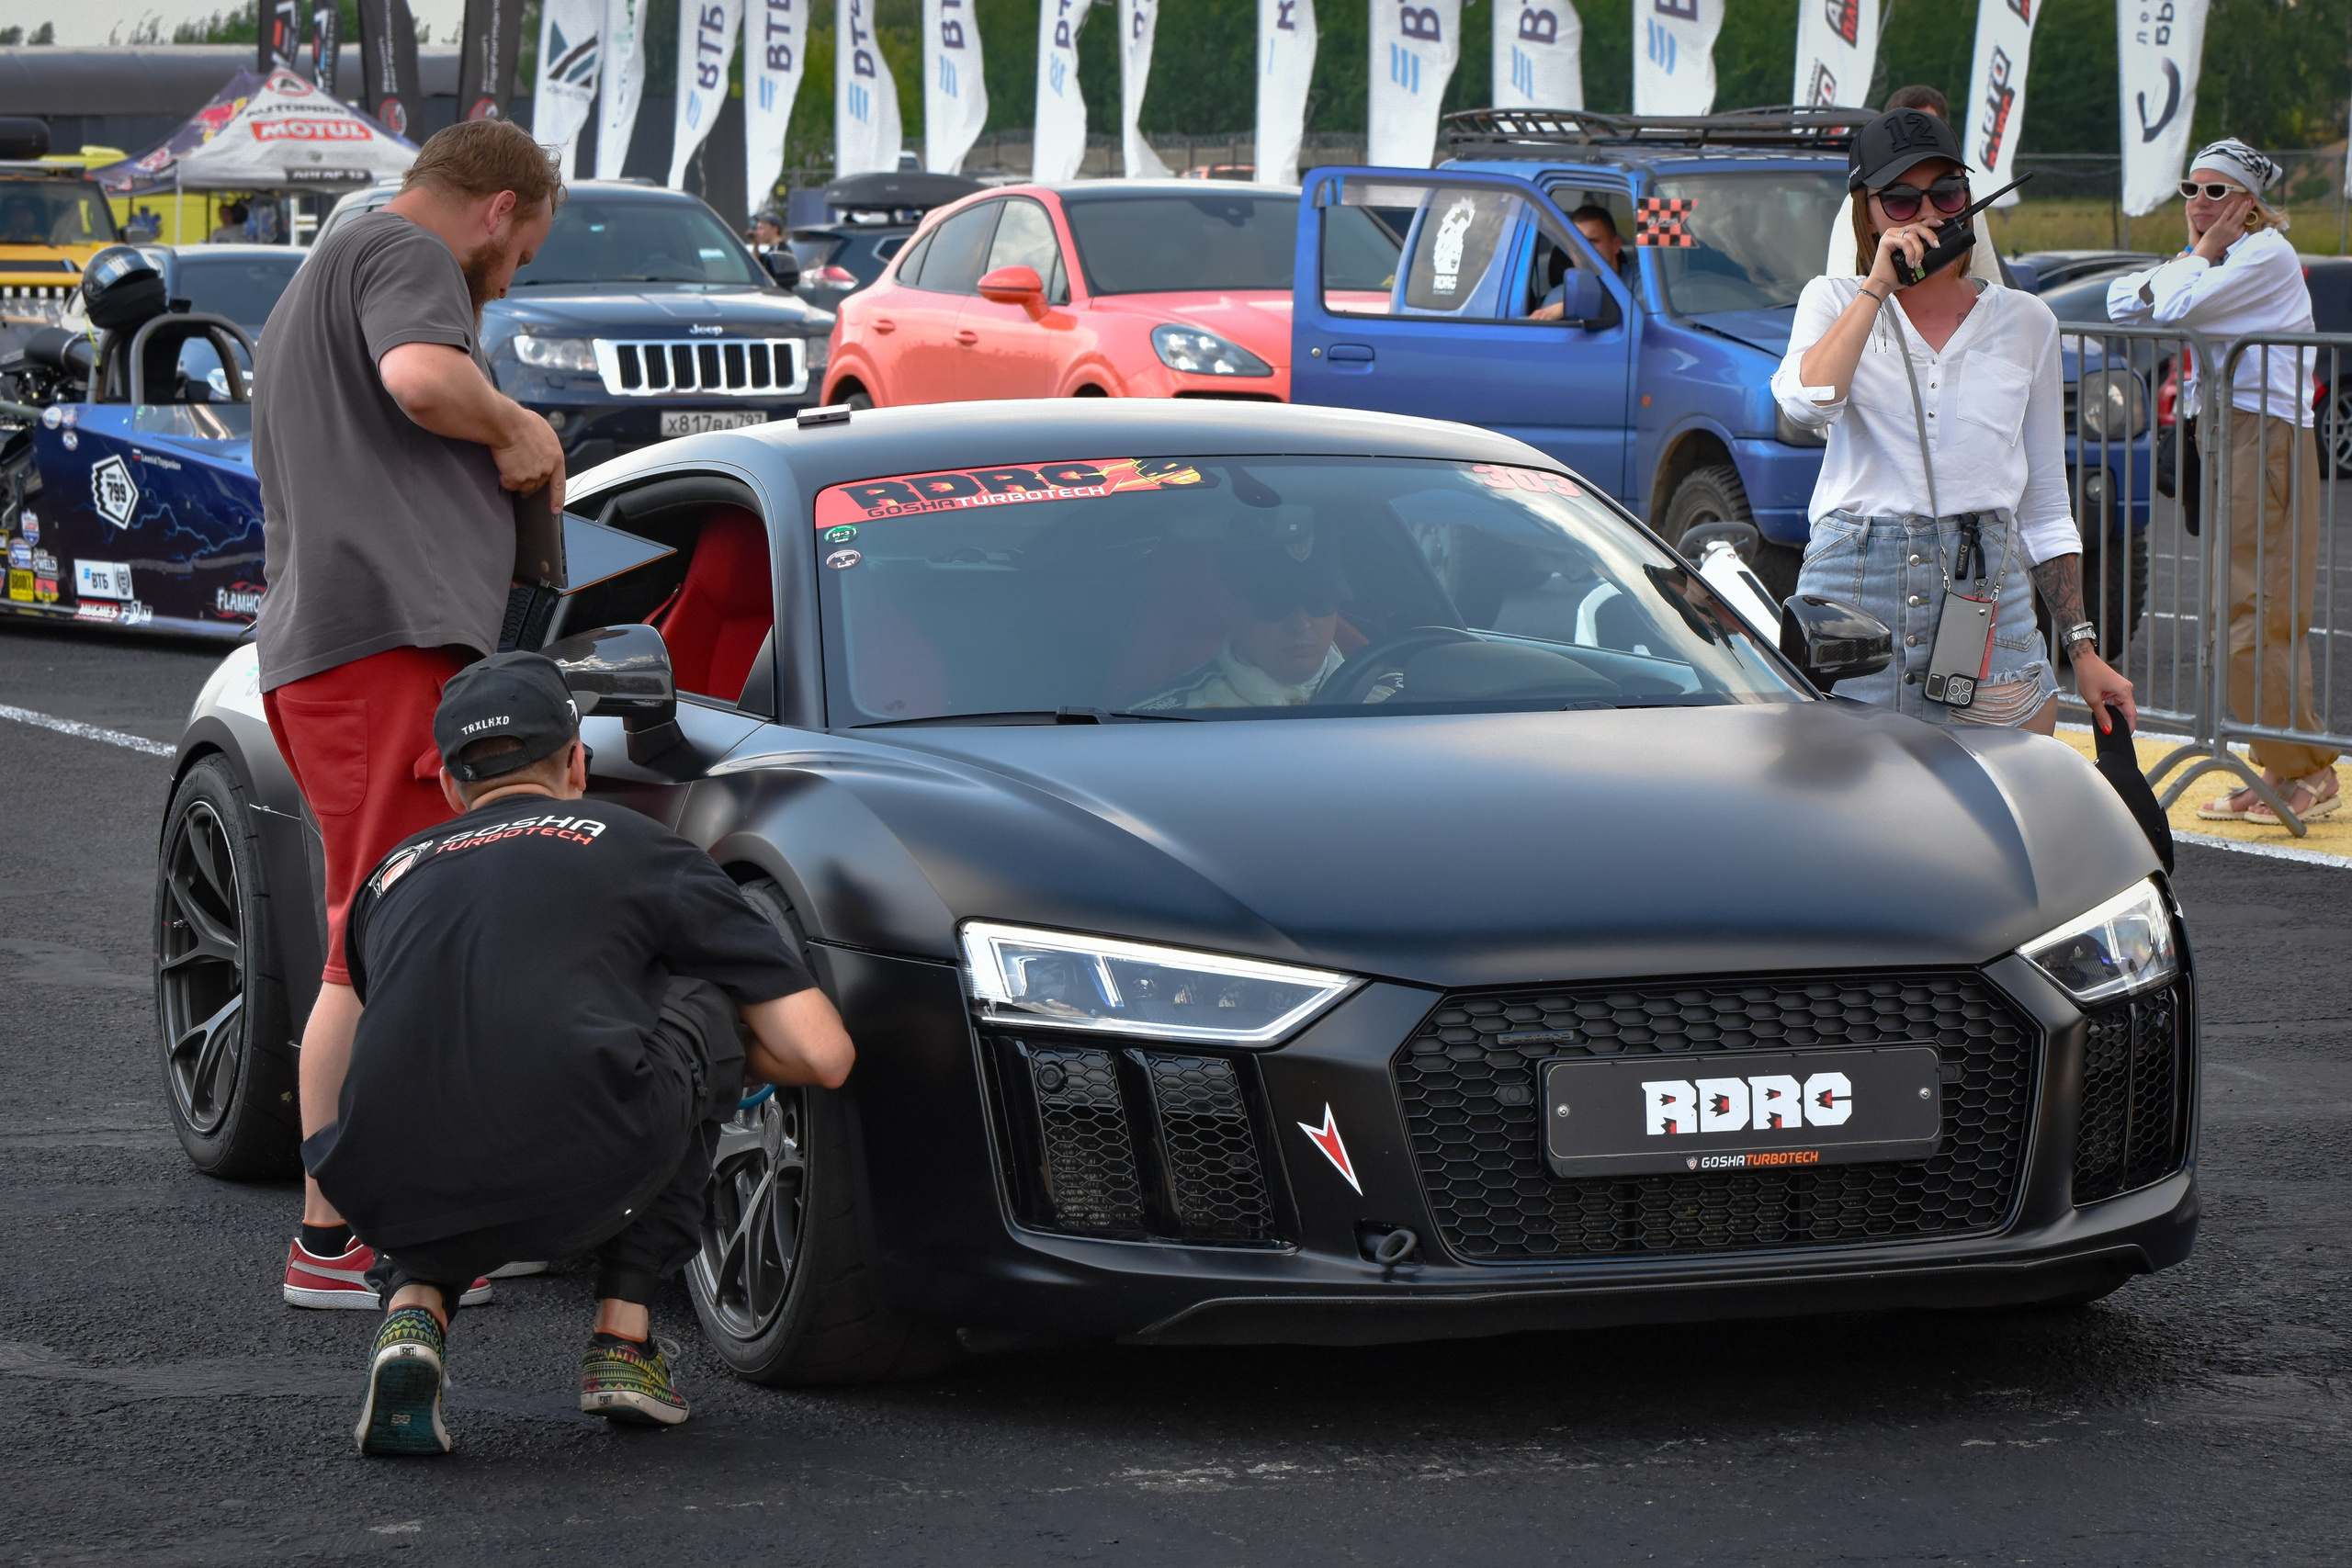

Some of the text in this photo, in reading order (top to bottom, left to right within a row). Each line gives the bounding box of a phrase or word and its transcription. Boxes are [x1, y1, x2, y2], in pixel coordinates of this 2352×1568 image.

[261, 122, 366, 138] MOTUL
[1884, 112, 1939, 153] 12
[689, 323, 723, 336] Jeep
[106, 481, 127, 503] 799
[838, 463, 1109, 510] RDRC
[1472, 465, 1581, 498] 303
[39, 558, 57, 571] WELD
[1957, 553, 1965, 571] years
[92, 572, 109, 590] ВТБ
[217, 587, 261, 614] FLAMHO
[461, 716, 510, 736] TRXLHXD
[435, 827, 593, 854] TURBOTECH
[442, 815, 606, 845] GOSHA
[1642, 1072, 1852, 1135] RDRC
